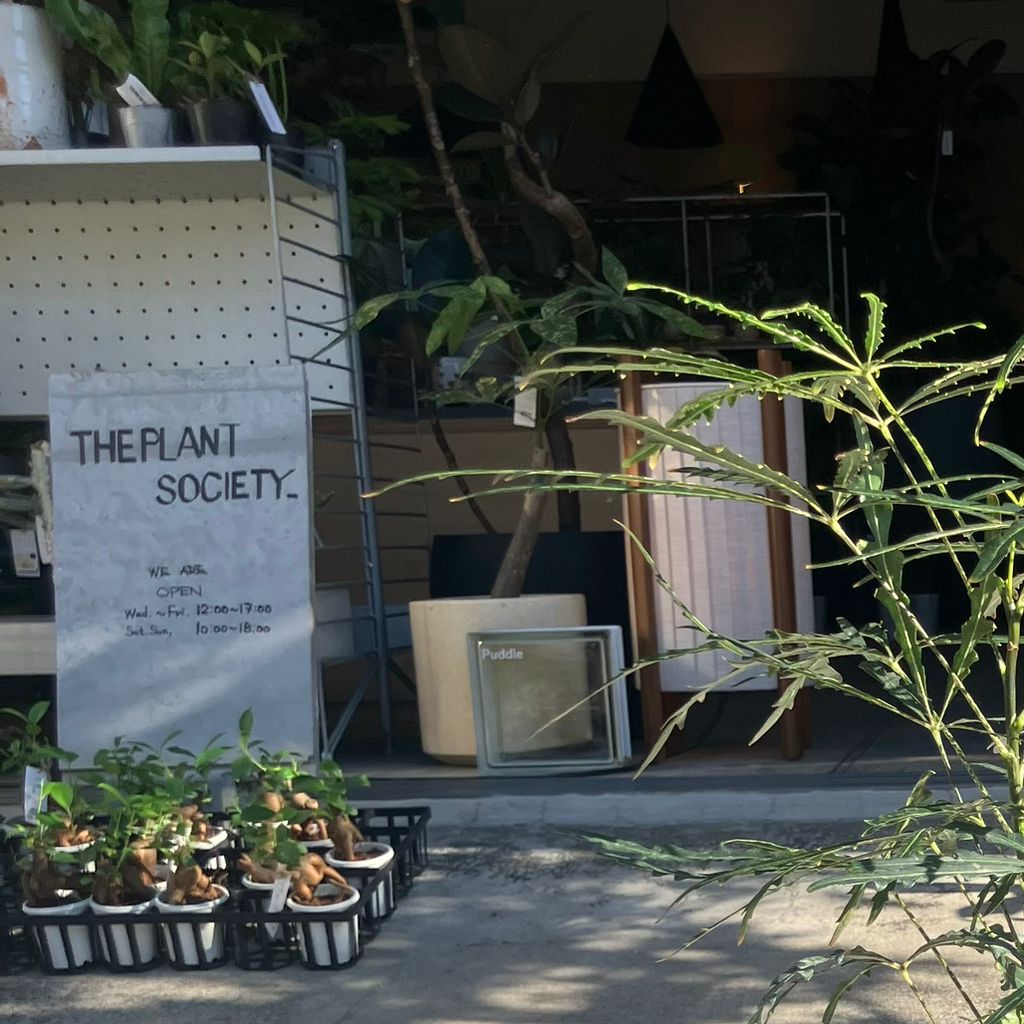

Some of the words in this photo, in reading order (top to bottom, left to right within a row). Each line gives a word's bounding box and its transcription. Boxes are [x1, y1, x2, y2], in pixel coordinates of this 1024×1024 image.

[149, 566, 172, 578] WE
[156, 584, 202, 598] OPEN
[481, 647, 524, 660] Puddle
